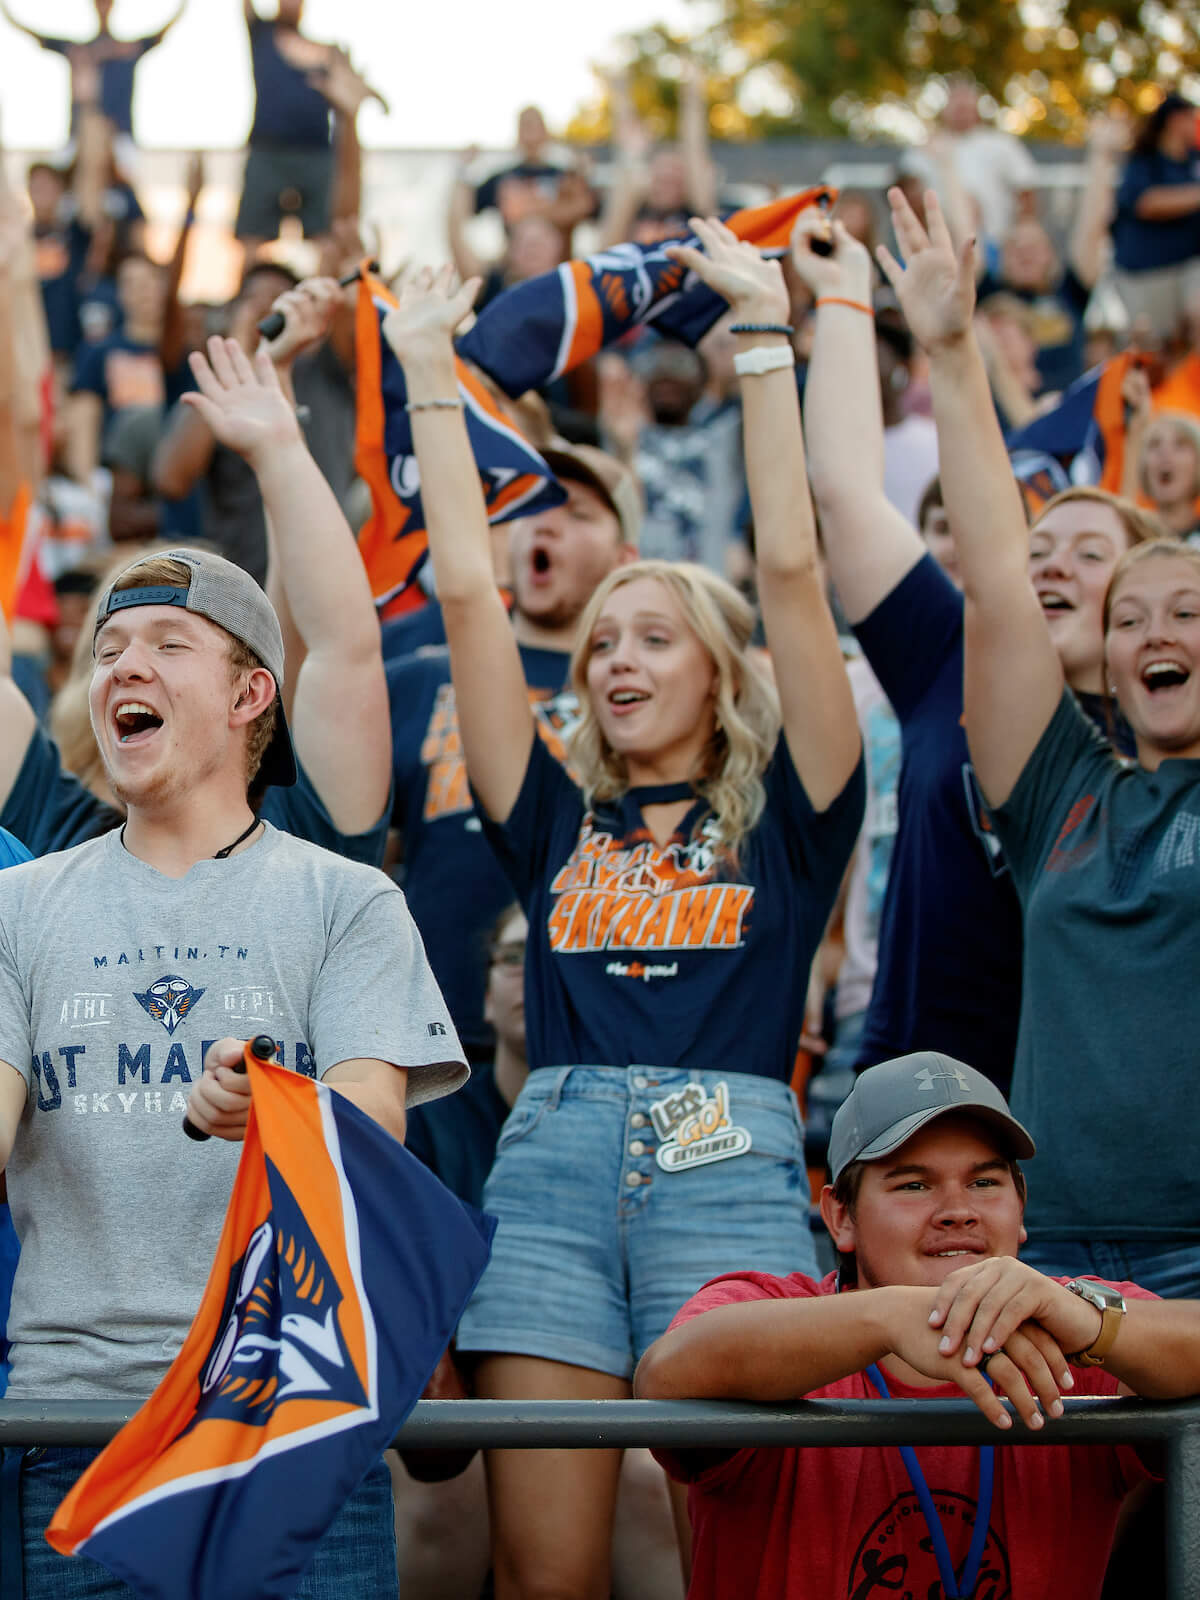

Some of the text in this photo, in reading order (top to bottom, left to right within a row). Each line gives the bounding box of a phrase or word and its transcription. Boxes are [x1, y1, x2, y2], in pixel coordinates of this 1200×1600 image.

[547, 883, 754, 953] SKYHAWK
[218, 946, 249, 960] TN
[74, 1091, 188, 1115] SKYHA
